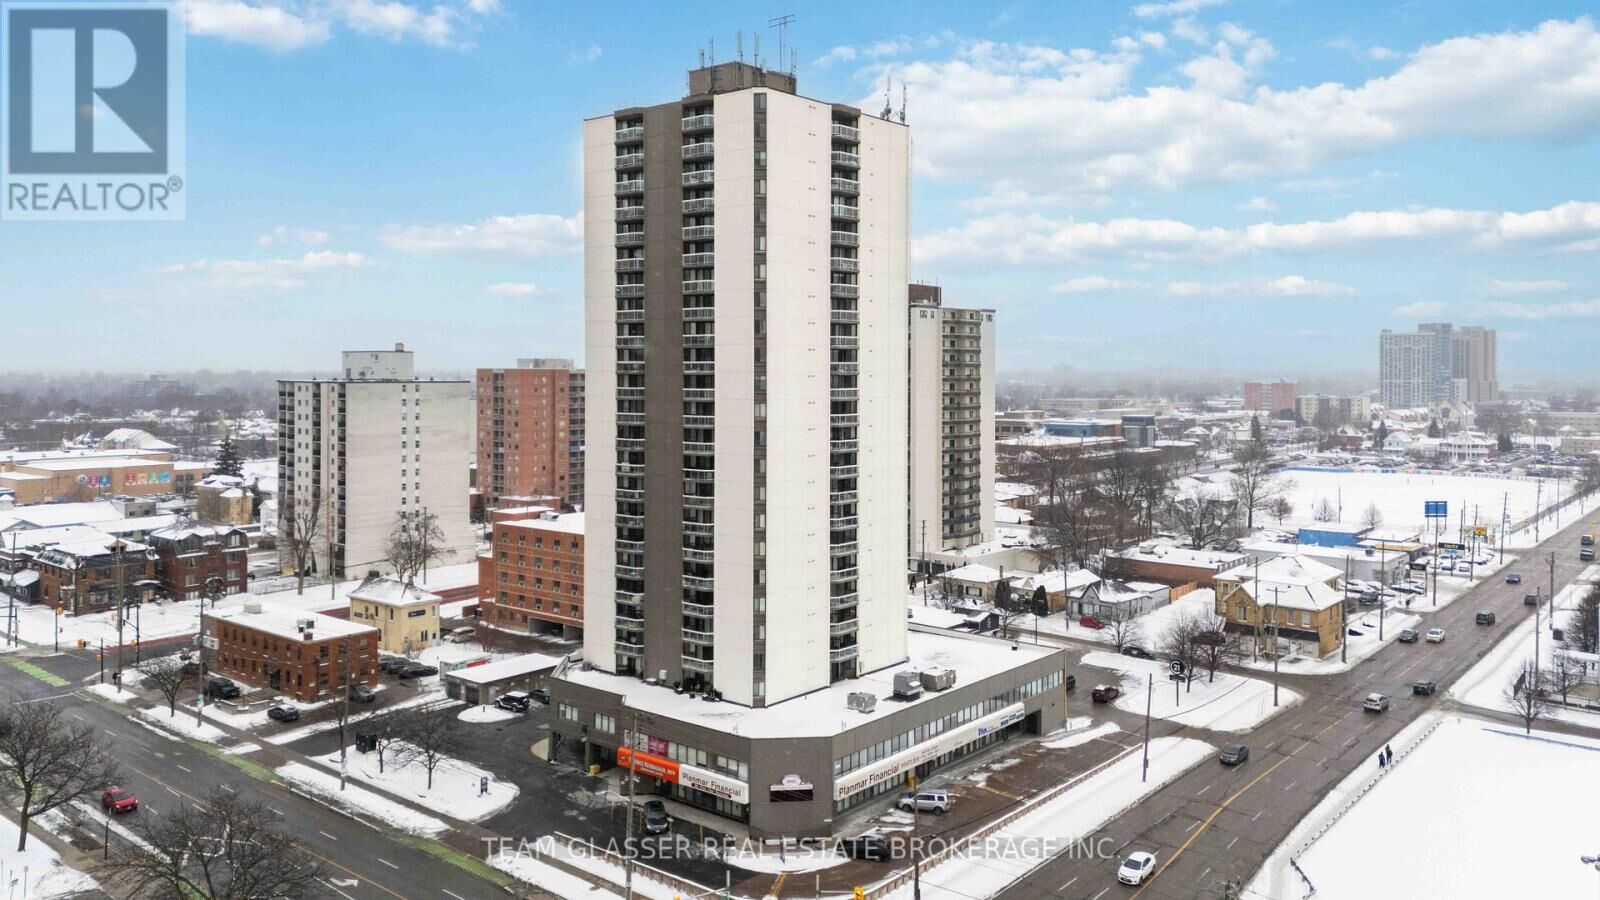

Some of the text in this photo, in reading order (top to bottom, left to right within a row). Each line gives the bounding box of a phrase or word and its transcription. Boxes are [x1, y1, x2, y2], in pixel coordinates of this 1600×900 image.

[682, 772, 709, 786] Planmar
[710, 780, 742, 797] Financial
[839, 778, 869, 797] Planmar
[869, 763, 899, 785] Financial
